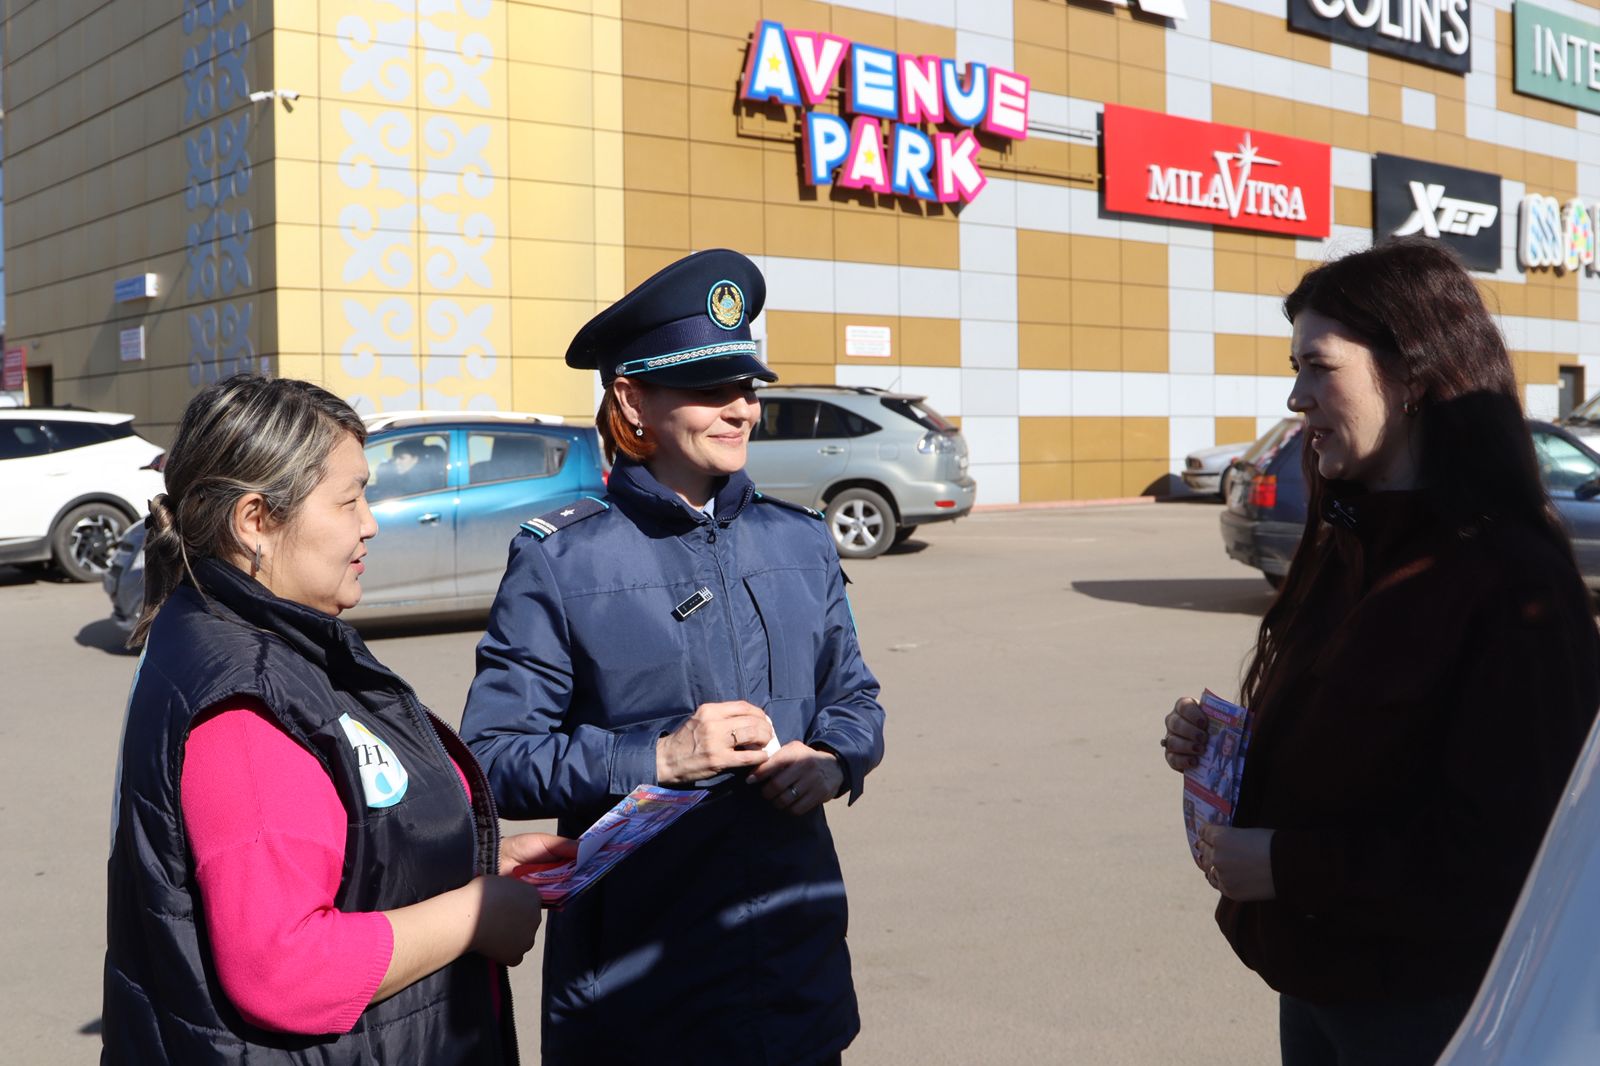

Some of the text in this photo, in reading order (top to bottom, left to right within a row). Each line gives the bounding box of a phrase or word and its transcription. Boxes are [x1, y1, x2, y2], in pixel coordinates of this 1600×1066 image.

[1309, 0, 1469, 55] LIN'S
[740, 19, 1030, 141] AVENUE
[803, 112, 988, 203] PARK
[1148, 148, 1307, 221] MILAVITSA
[1392, 180, 1498, 238] XTEP
